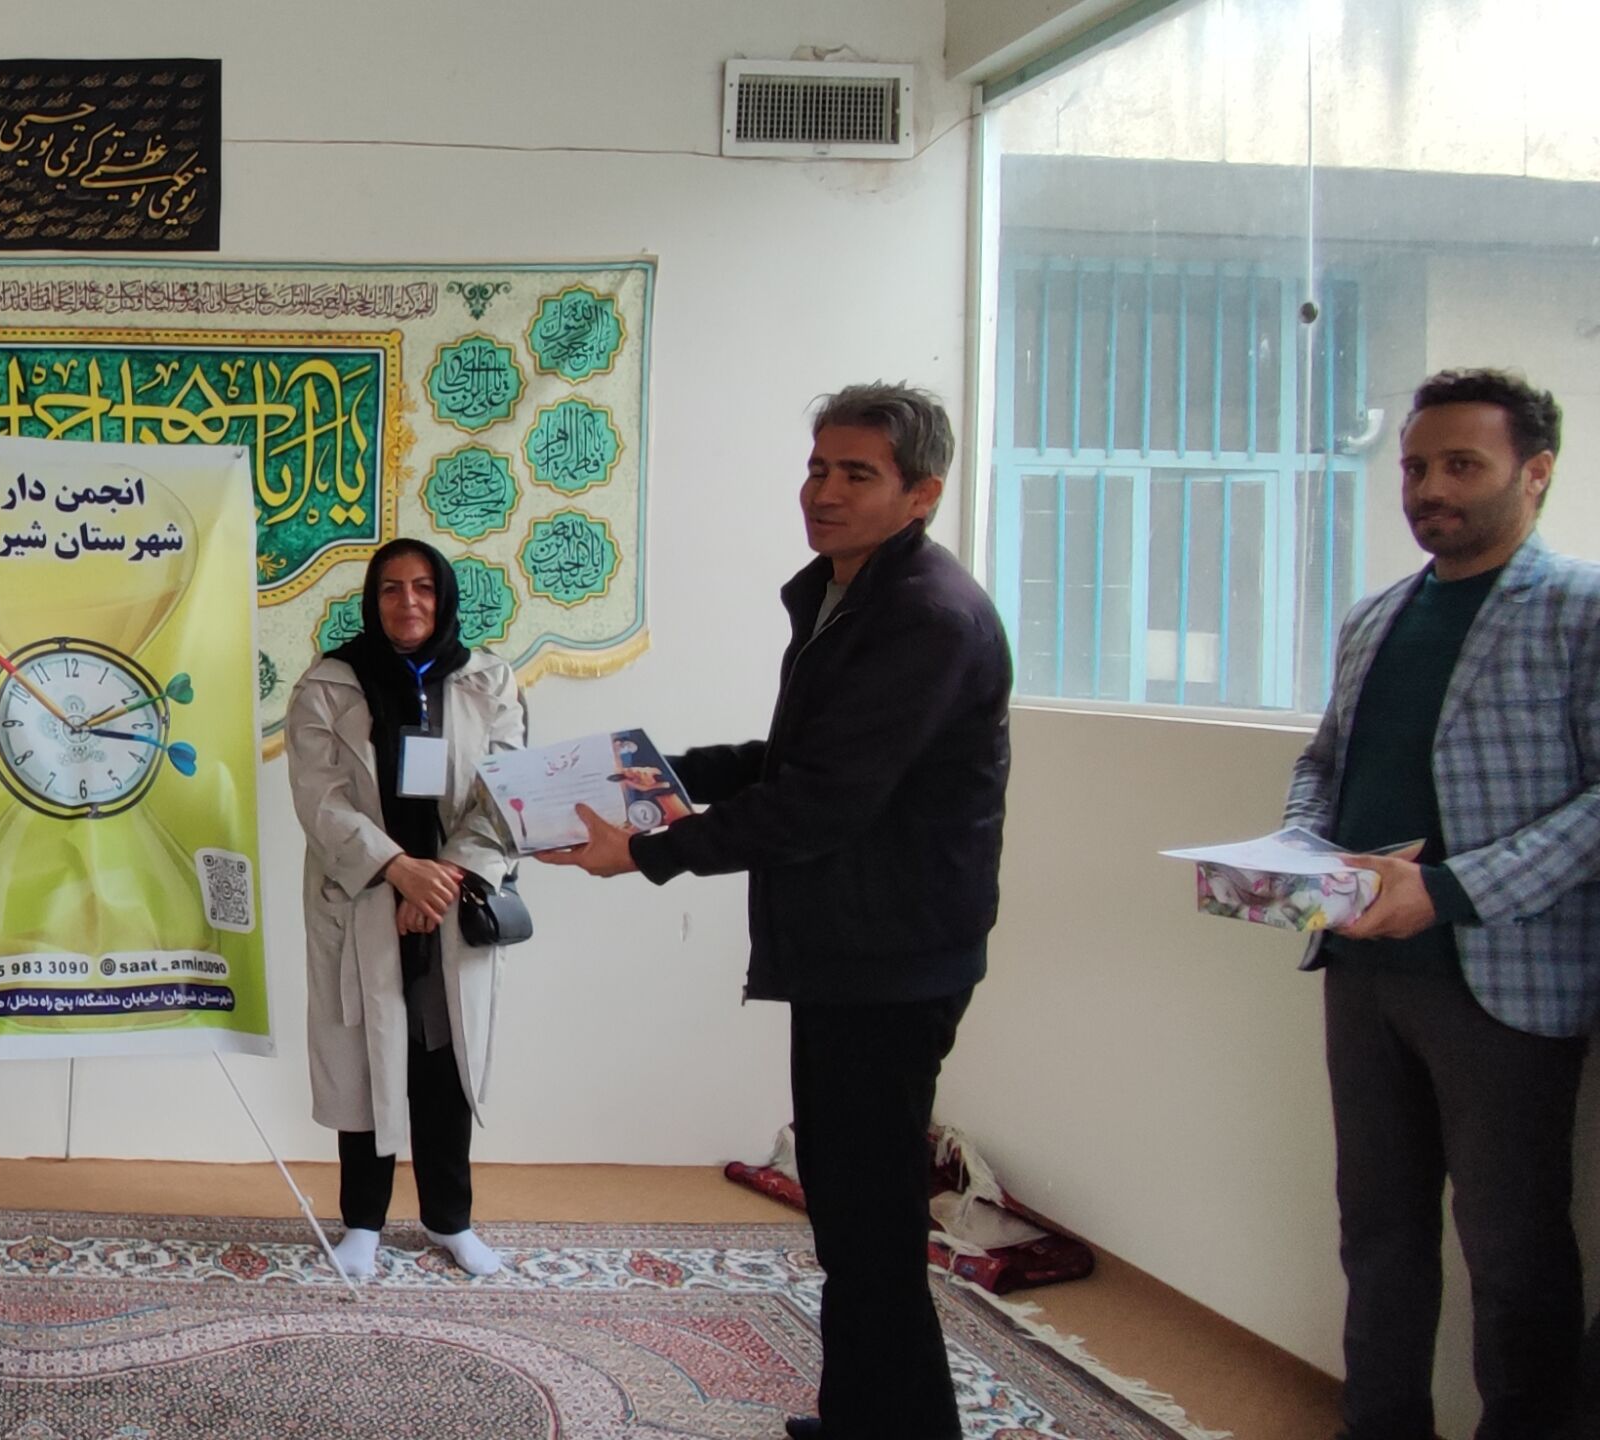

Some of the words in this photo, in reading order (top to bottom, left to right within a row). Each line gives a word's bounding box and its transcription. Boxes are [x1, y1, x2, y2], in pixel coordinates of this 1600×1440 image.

[54, 477, 146, 514] انجمن
[53, 520, 184, 561] شهرستان
[63, 658, 80, 678] 12
[79, 778, 88, 800] 6
[11, 961, 43, 975] 983
[48, 961, 89, 974] 3090
[40, 994, 53, 1011] راه
[53, 996, 74, 1011] پنج
[121, 990, 159, 1009] خیابان
